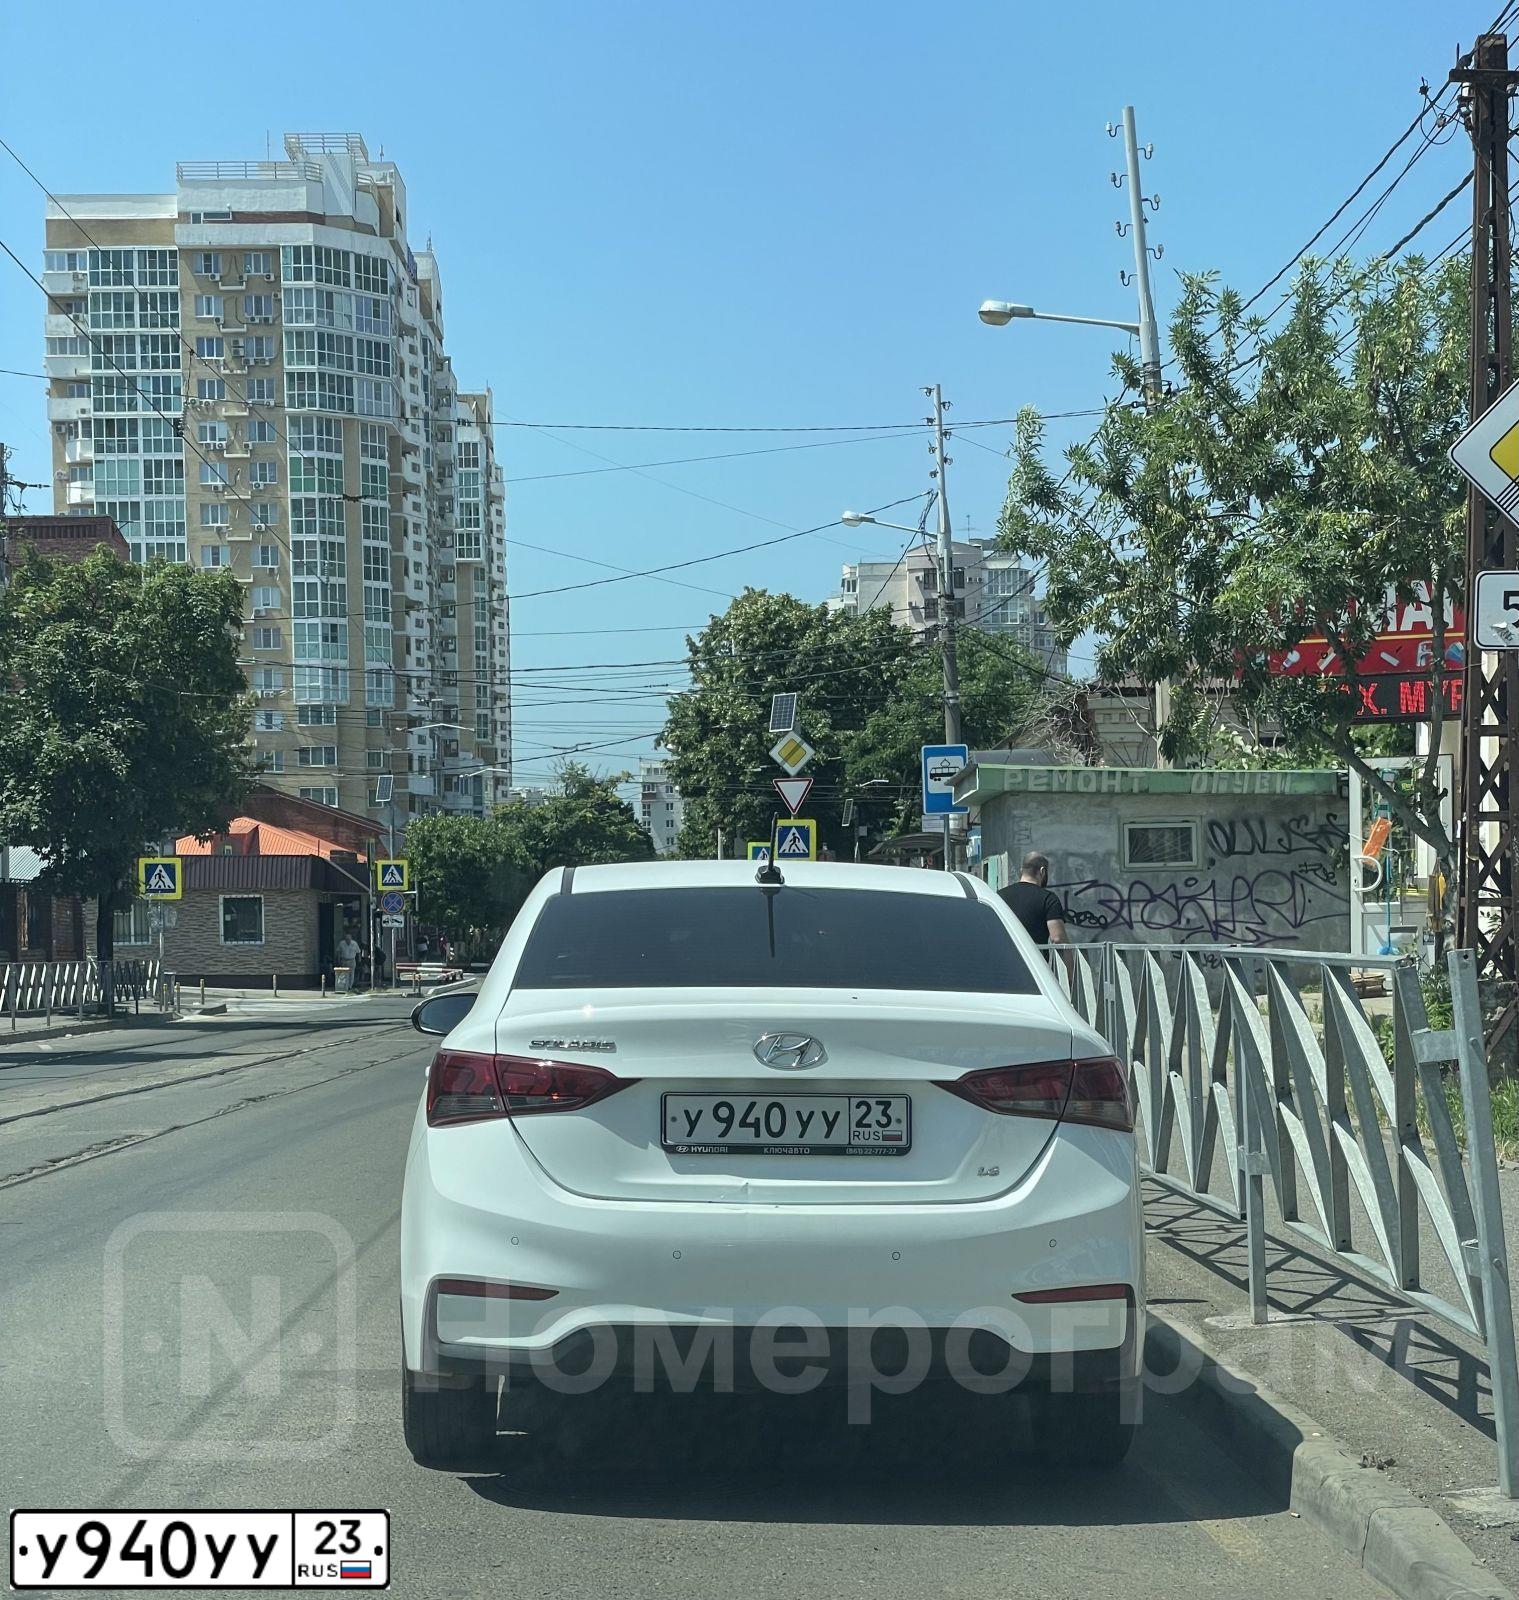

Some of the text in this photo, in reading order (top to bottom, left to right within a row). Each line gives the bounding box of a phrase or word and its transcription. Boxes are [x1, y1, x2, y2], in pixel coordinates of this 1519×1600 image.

[1003, 768, 1148, 794] РЕМОНТ
[529, 1039, 617, 1053] SOLARIS
[854, 1100, 892, 1129] 23
[852, 1130, 881, 1142] RUS
[691, 1146, 728, 1154] HYUNDAI
